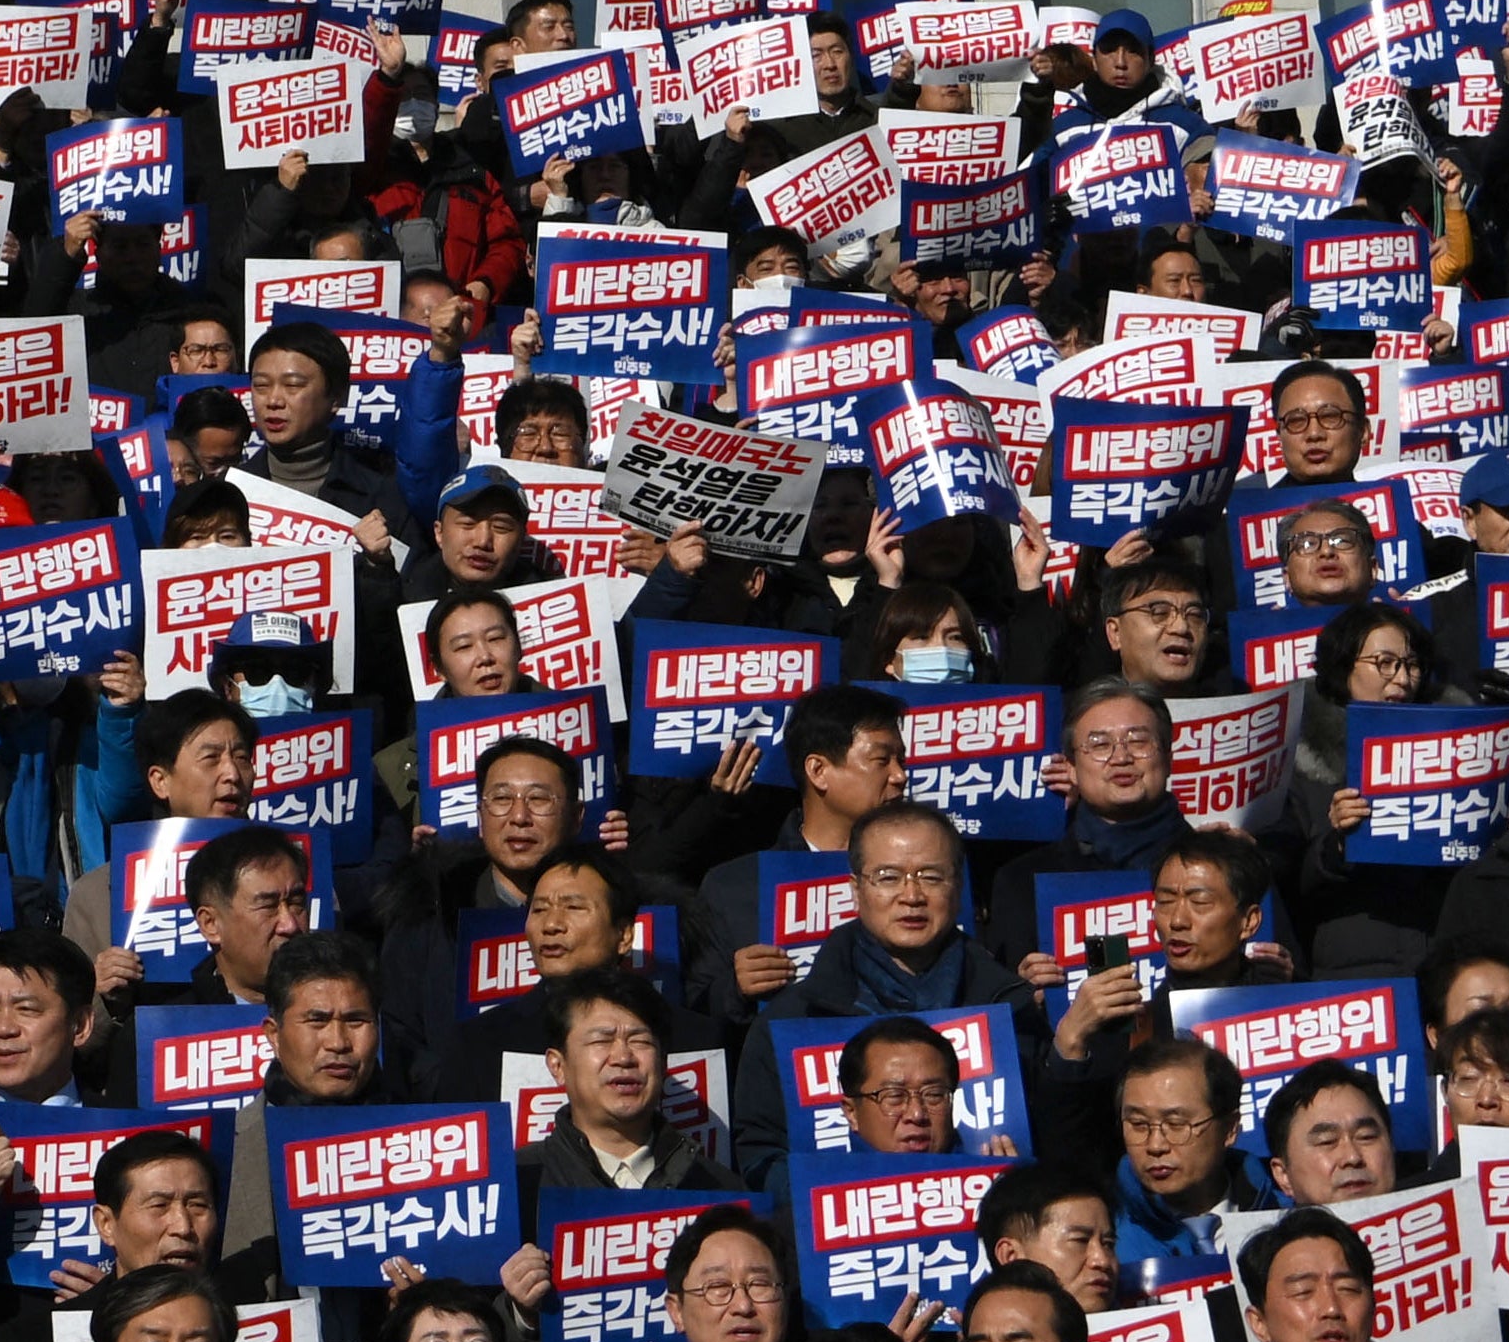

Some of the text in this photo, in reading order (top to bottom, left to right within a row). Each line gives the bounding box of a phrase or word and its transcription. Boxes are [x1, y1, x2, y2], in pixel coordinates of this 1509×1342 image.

[1207, 20, 1303, 75] 윤석열은
[234, 68, 340, 118] 윤석열은
[511, 61, 619, 132] 내란행위
[238, 103, 353, 151] 사퇴하라!
[519, 93, 626, 163] 즉각수사!
[1309, 235, 1416, 275] 내란행위
[555, 258, 703, 306] 내란행위
[1308, 273, 1425, 313] 즉각수사!
[553, 307, 715, 355] 즉각수사!
[627, 411, 812, 475] 친일매국노
[1071, 420, 1225, 473] 내란행위
[618, 443, 783, 506] 윤석열을
[629, 481, 804, 543] 탄핵하자!
[1069, 475, 1227, 525] 즉각수사!
[655, 649, 814, 699] 내란행위
